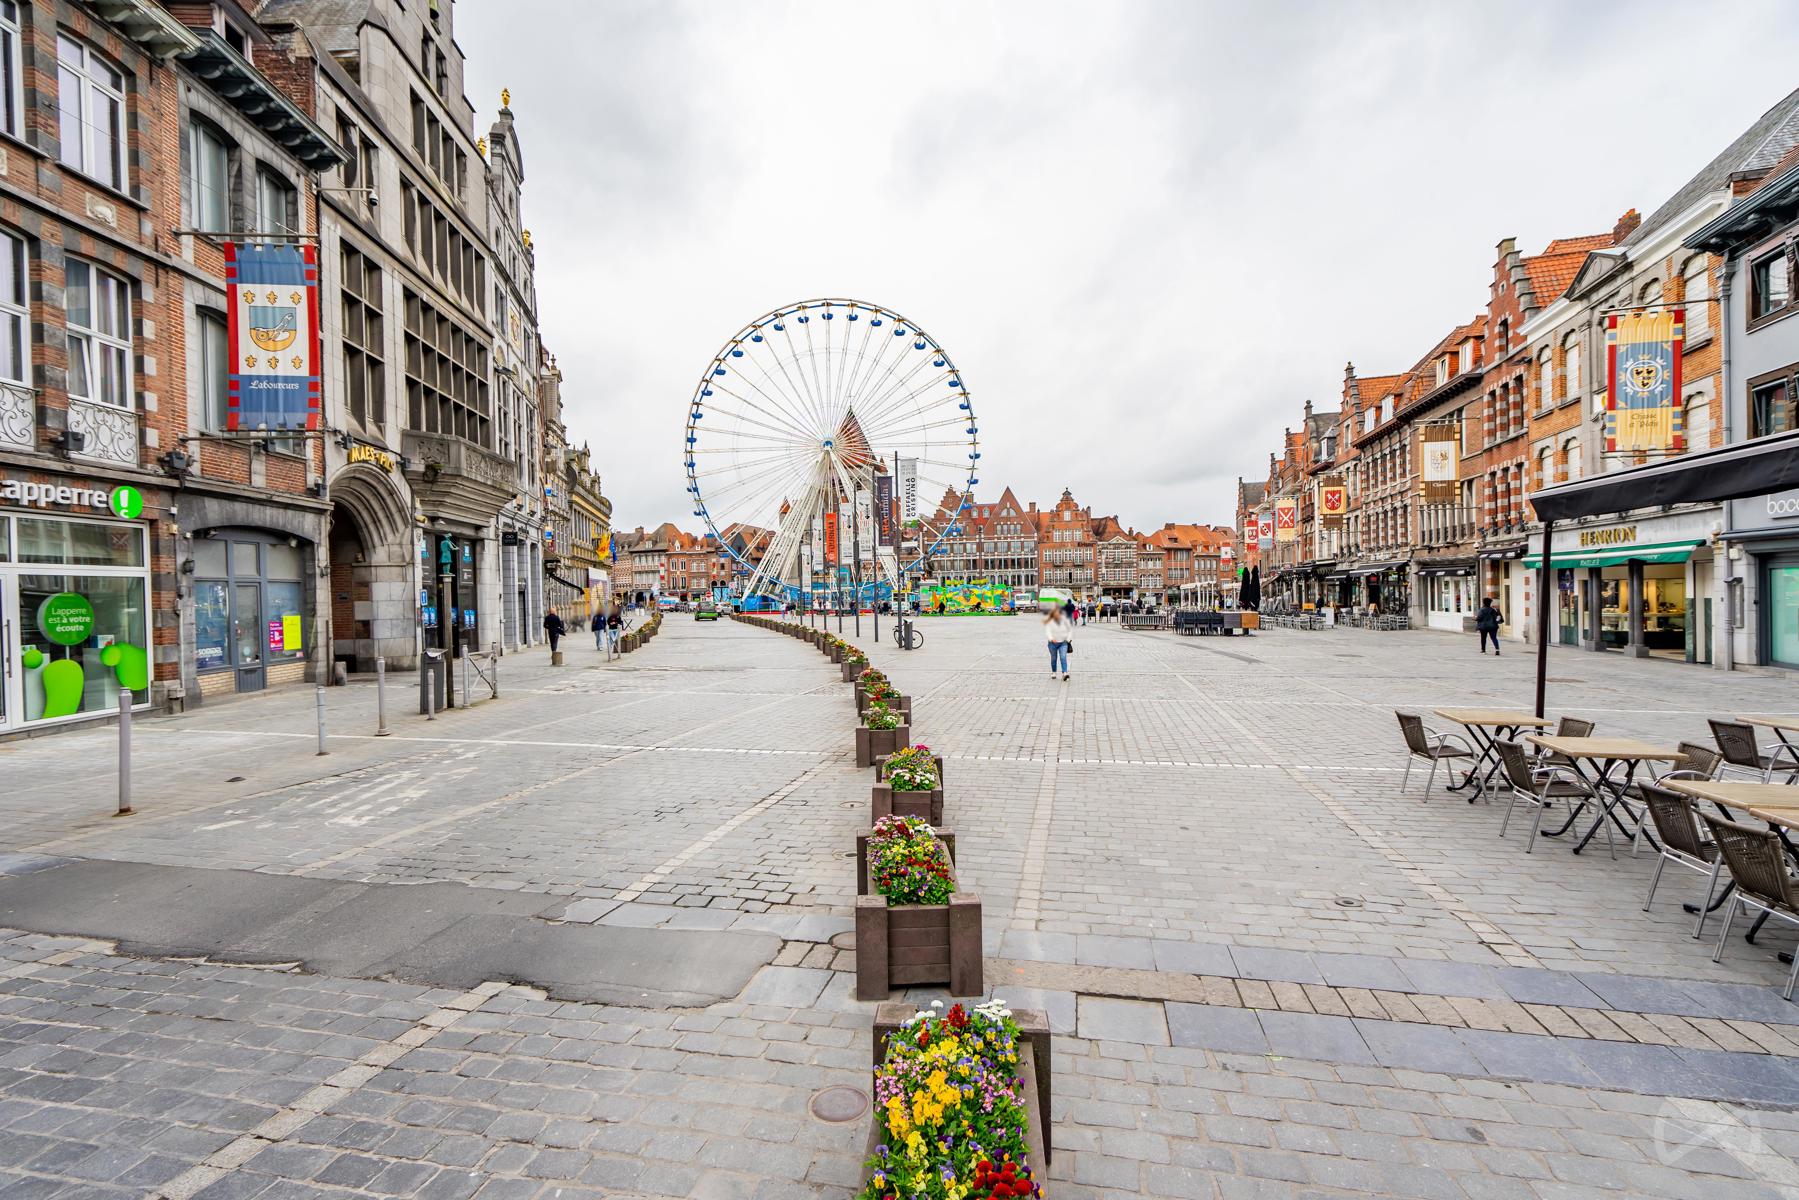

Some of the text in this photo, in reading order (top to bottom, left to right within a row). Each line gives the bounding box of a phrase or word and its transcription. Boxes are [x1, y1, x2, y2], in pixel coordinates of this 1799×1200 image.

[249, 380, 300, 390] Laboureurs
[0, 480, 109, 507] apperre
[1580, 525, 1637, 547] HENRION
[51, 607, 88, 616] Lapperre
[56, 624, 84, 632] écoute
